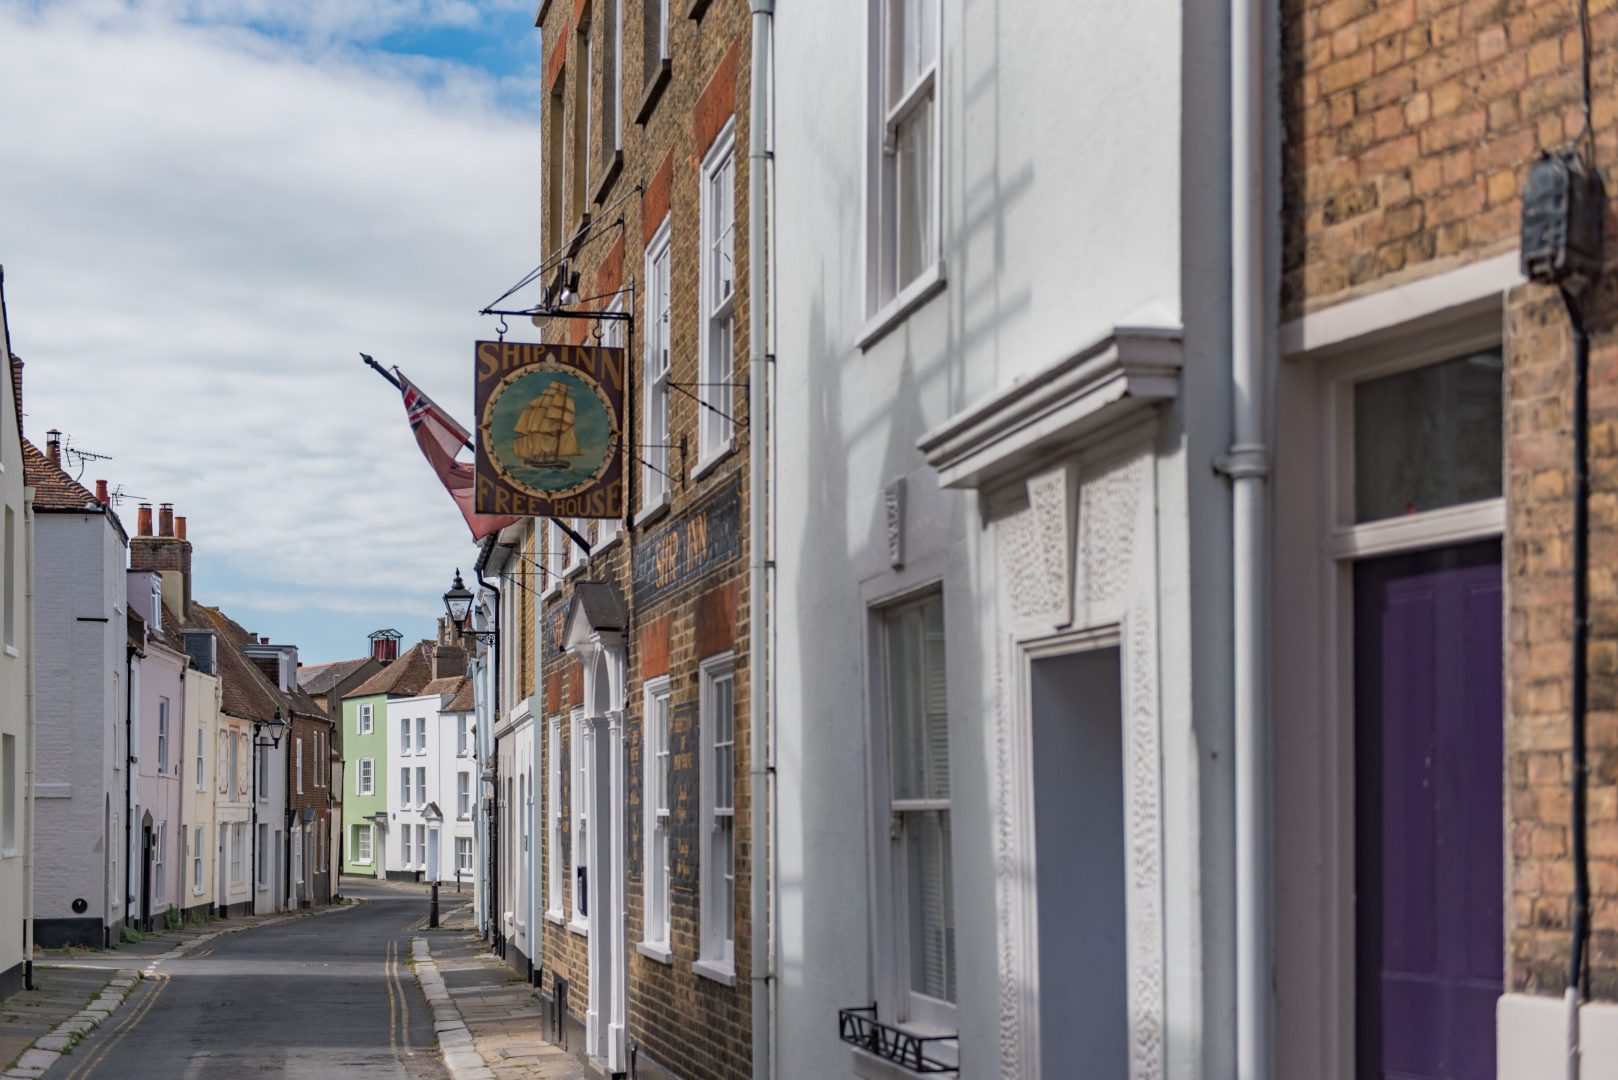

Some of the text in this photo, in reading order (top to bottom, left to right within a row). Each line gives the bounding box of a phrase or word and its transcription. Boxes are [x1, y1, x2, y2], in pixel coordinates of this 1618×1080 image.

[478, 343, 623, 391] SHIP INN
[477, 471, 622, 517] FREE HOUSE
[655, 511, 707, 588] SHIP INN
